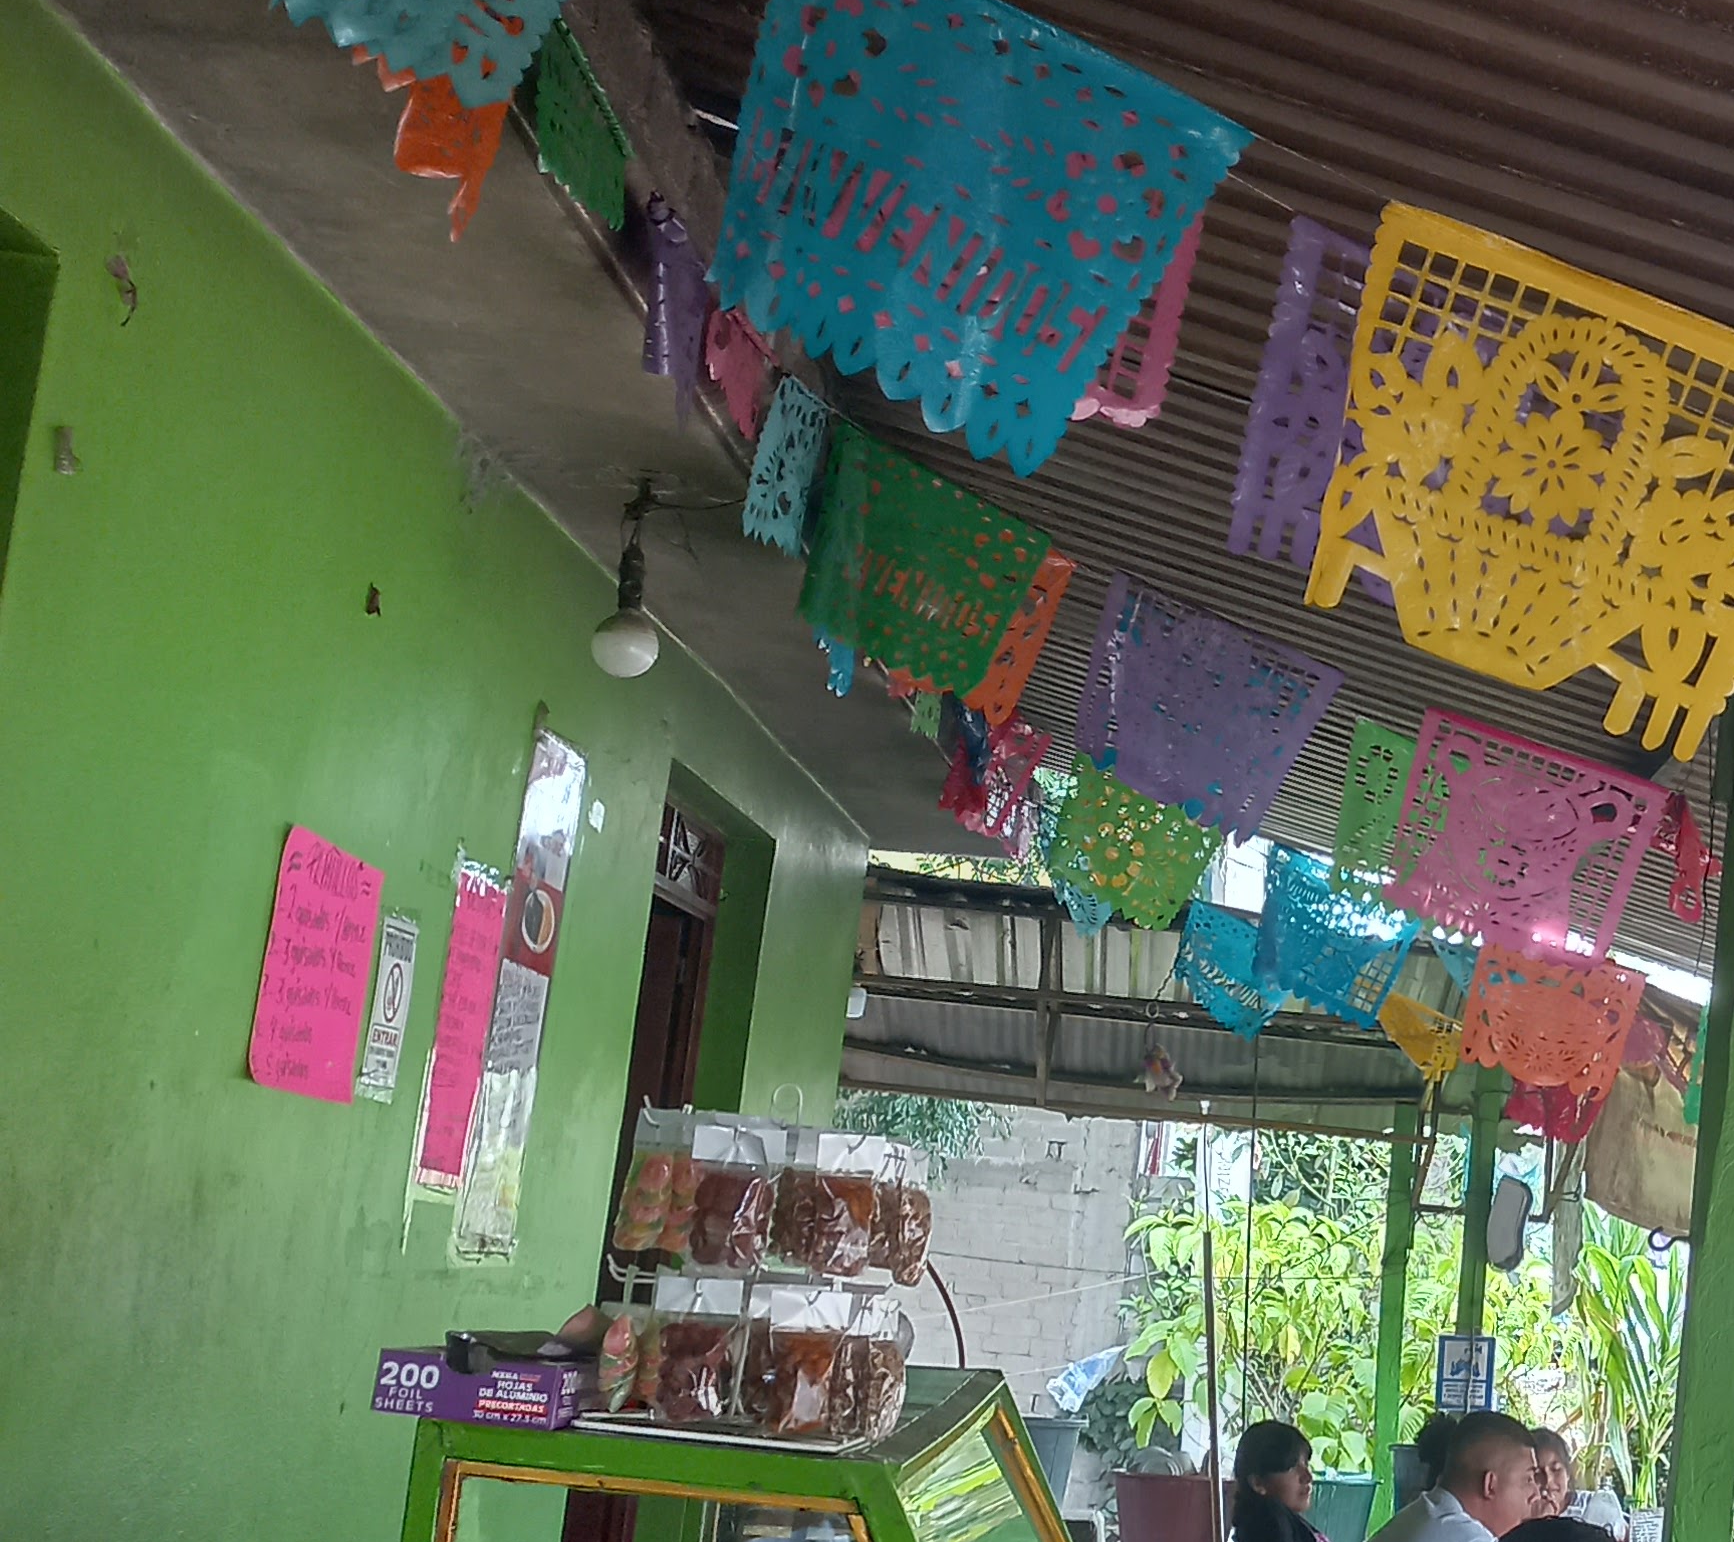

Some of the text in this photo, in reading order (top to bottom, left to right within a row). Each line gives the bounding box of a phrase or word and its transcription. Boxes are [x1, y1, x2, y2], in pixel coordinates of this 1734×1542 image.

[380, 1361, 440, 1390] 200
[389, 1387, 423, 1400] FOIL
[496, 1380, 533, 1392] HOJAS
[478, 1387, 549, 1403] DE ALUMINIO
[375, 1397, 434, 1414] SHEETS
[478, 1399, 545, 1413] PRECORTADAS
